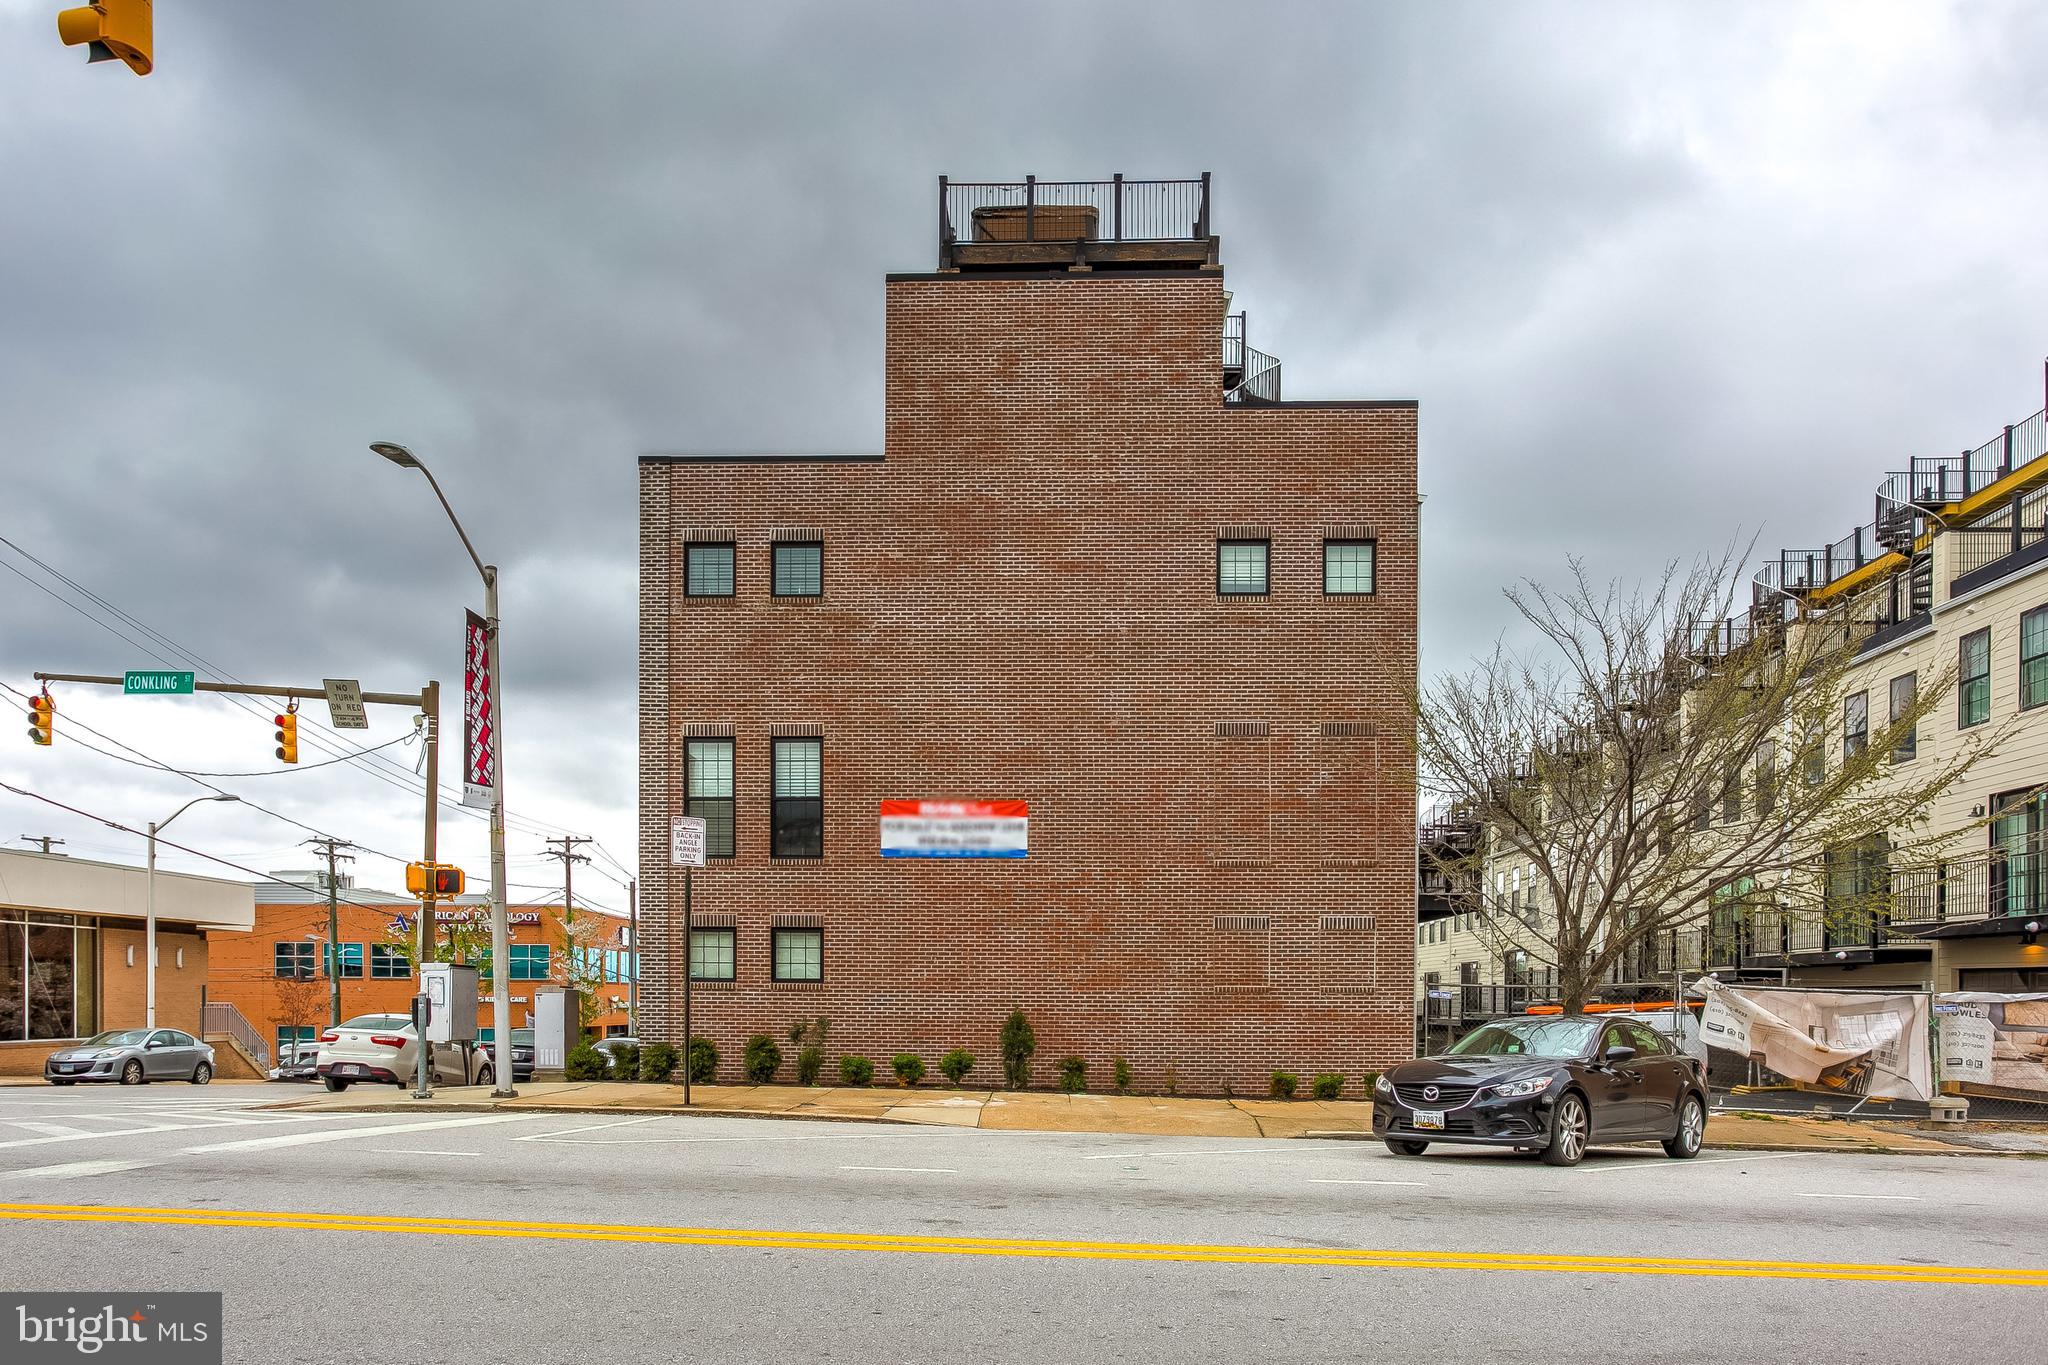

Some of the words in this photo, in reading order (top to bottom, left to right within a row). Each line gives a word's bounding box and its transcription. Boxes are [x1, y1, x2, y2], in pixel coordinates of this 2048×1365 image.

[127, 675, 178, 690] CONKLING
[334, 694, 354, 702] TURN
[330, 703, 342, 711] ON
[346, 703, 362, 711] RED
[676, 832, 701, 840] BACK-IN
[679, 839, 698, 847] ANGLE
[675, 846, 702, 854] PARKING
